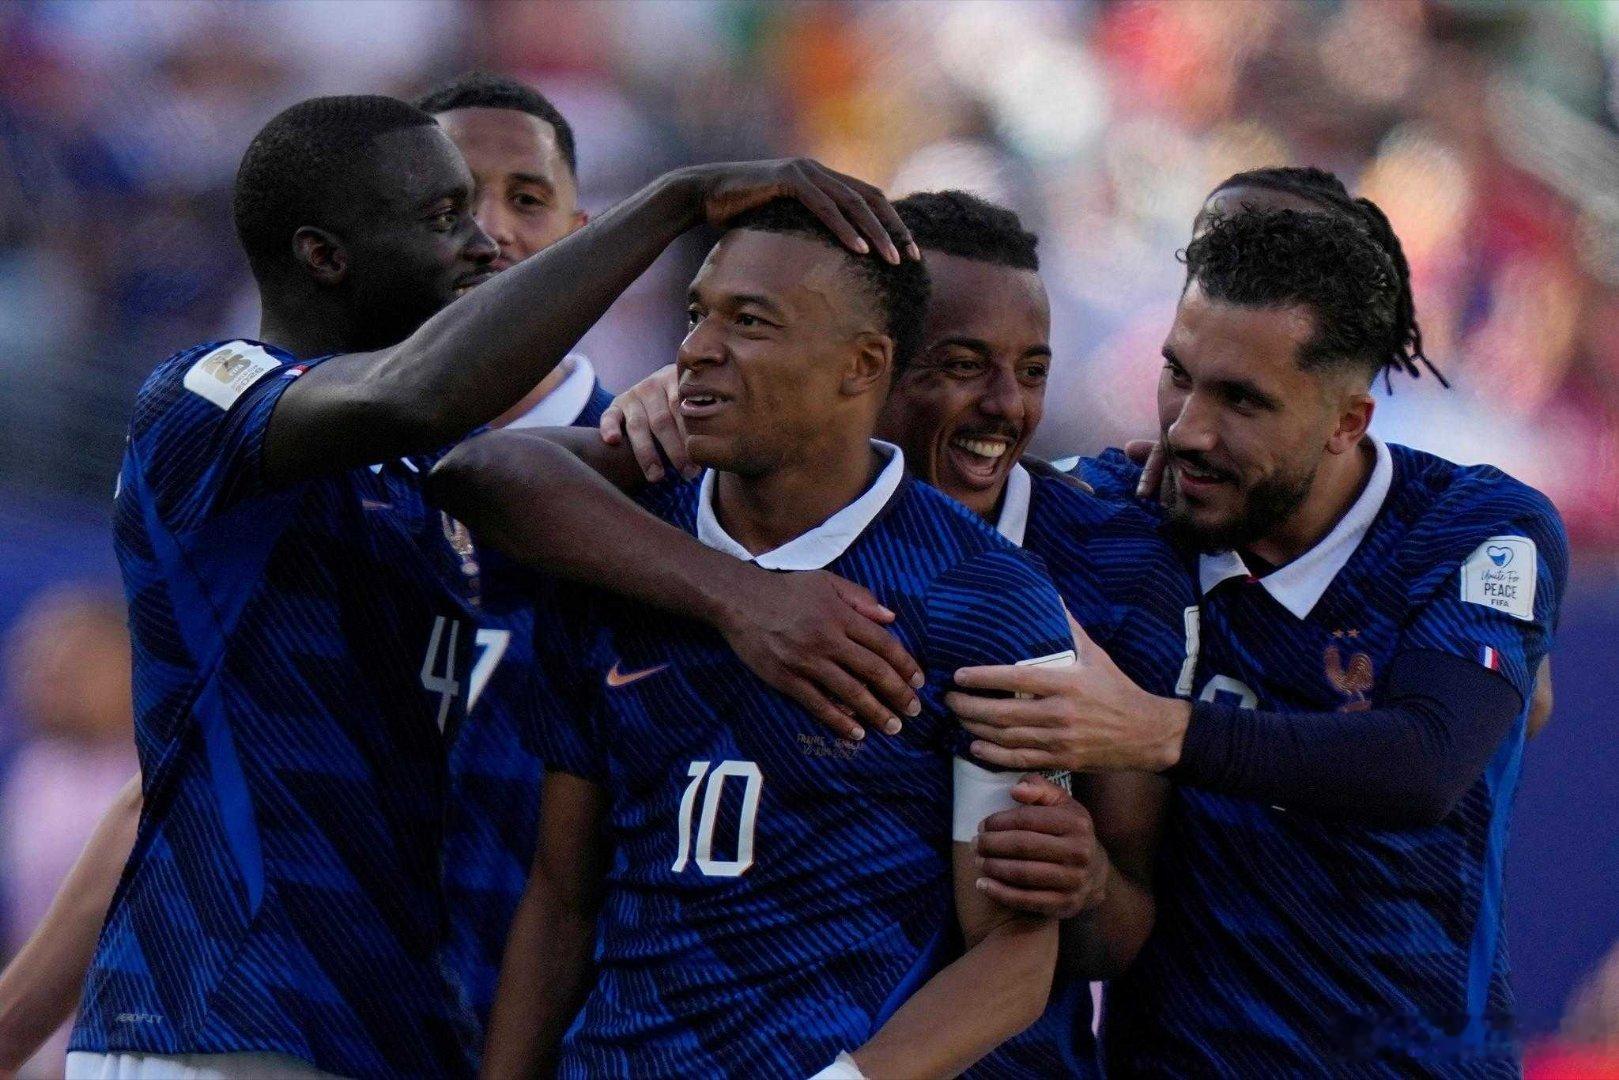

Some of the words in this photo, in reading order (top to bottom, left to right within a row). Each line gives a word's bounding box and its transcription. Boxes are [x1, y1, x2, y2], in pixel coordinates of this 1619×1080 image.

[1484, 582, 1517, 600] PEACE
[1491, 599, 1509, 607] FIFA
[420, 615, 459, 734] 4
[466, 627, 511, 715] 7
[671, 760, 763, 876] 10
